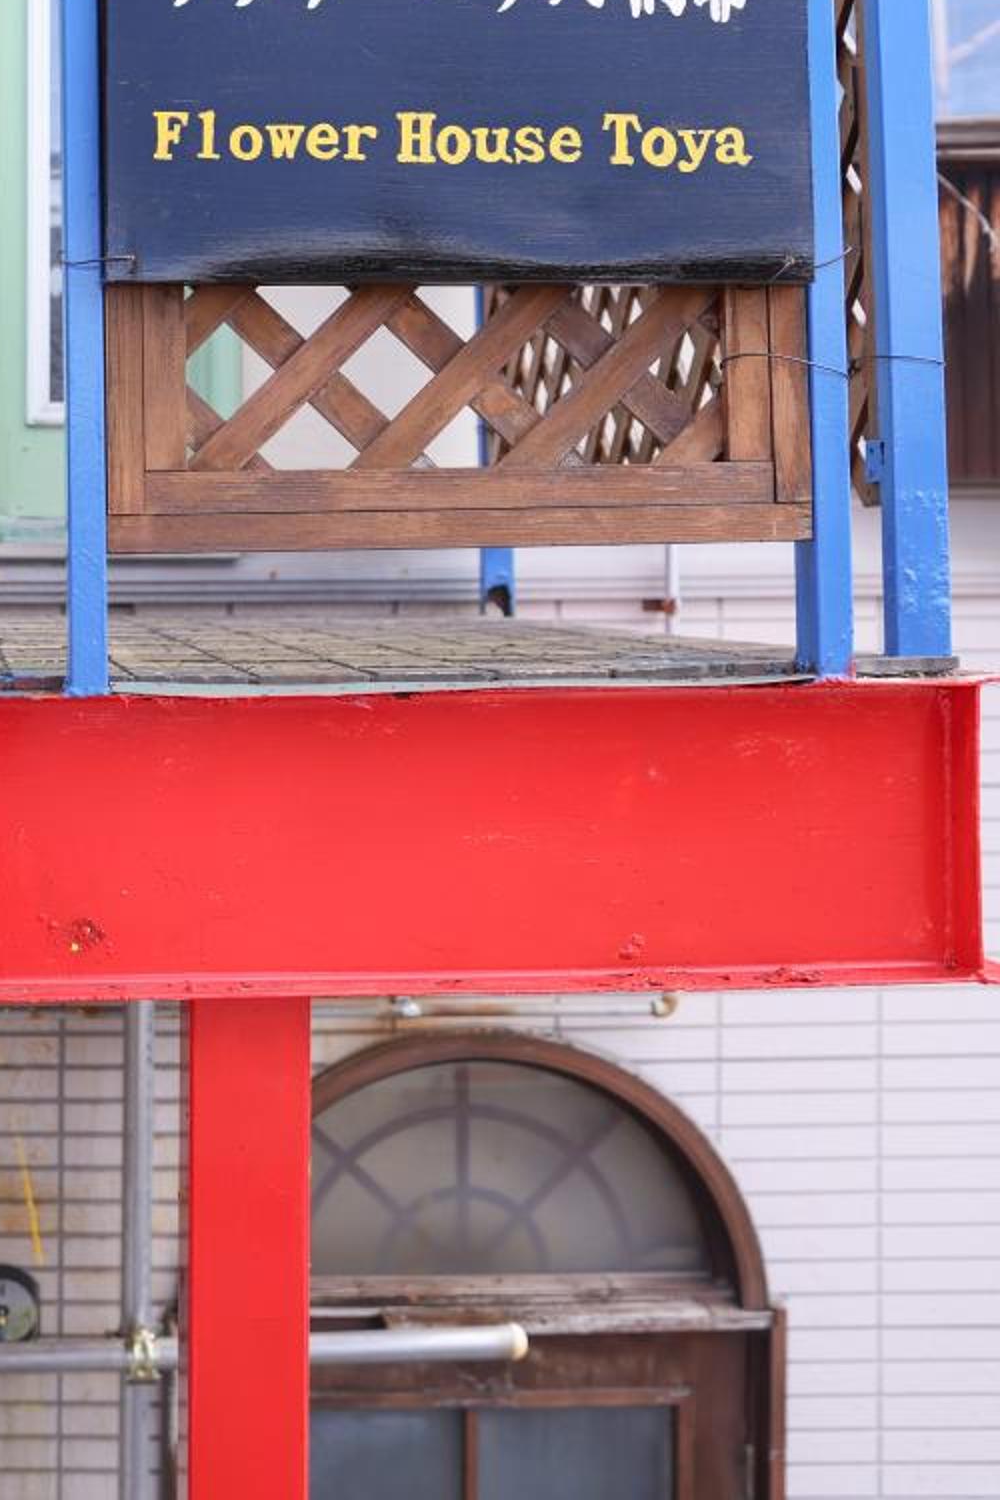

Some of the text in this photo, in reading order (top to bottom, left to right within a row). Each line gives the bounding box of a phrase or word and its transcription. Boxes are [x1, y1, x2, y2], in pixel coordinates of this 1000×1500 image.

[153, 110, 752, 172] Flower House Toya
